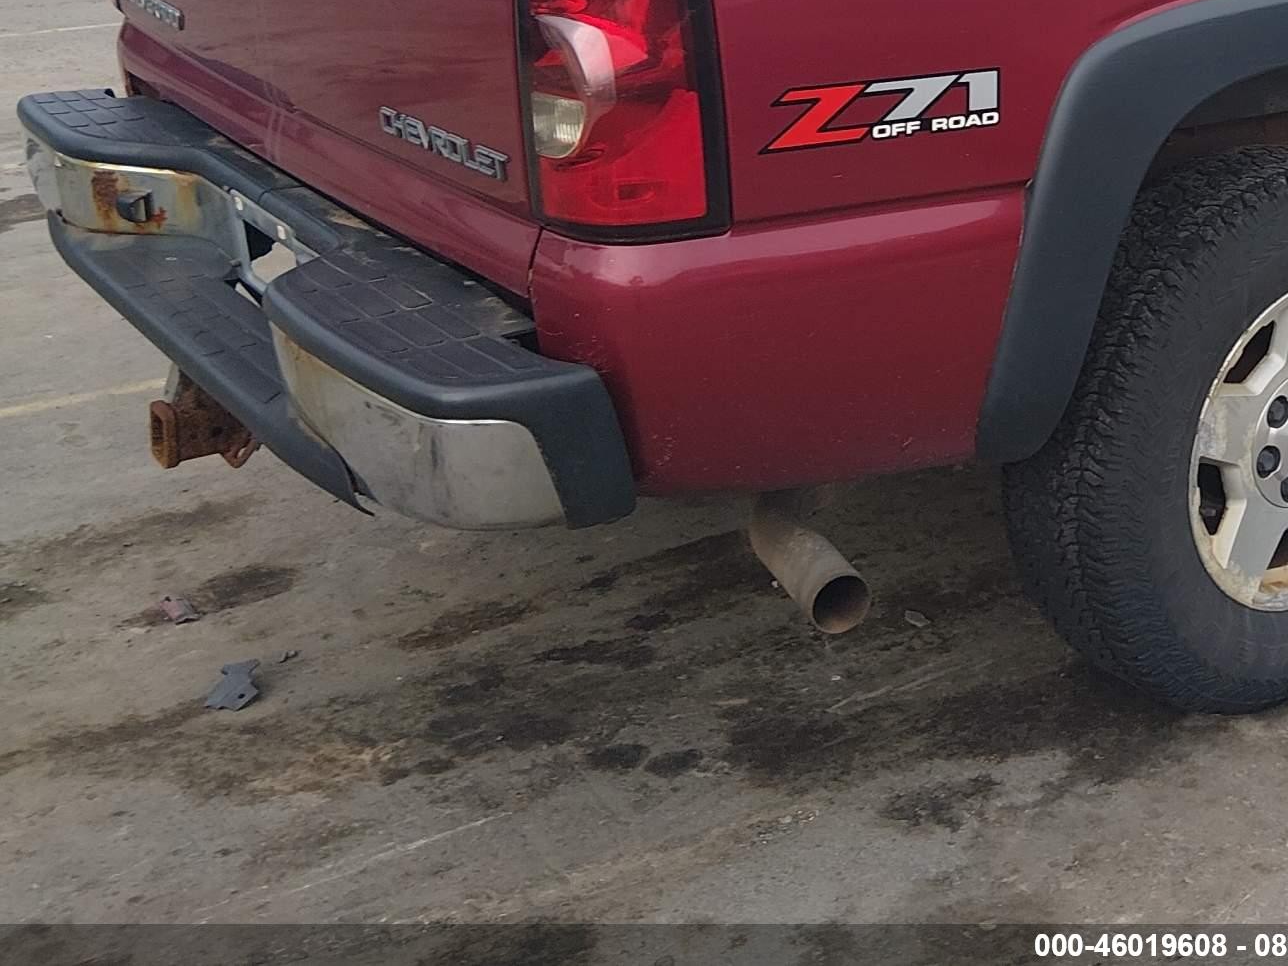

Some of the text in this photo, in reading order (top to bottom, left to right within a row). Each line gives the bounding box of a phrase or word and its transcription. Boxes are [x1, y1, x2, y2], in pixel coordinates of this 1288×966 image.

[379, 106, 509, 181] CHEVROLET
[762, 69, 999, 151] Z71
[871, 111, 999, 139] OFF ROAD
